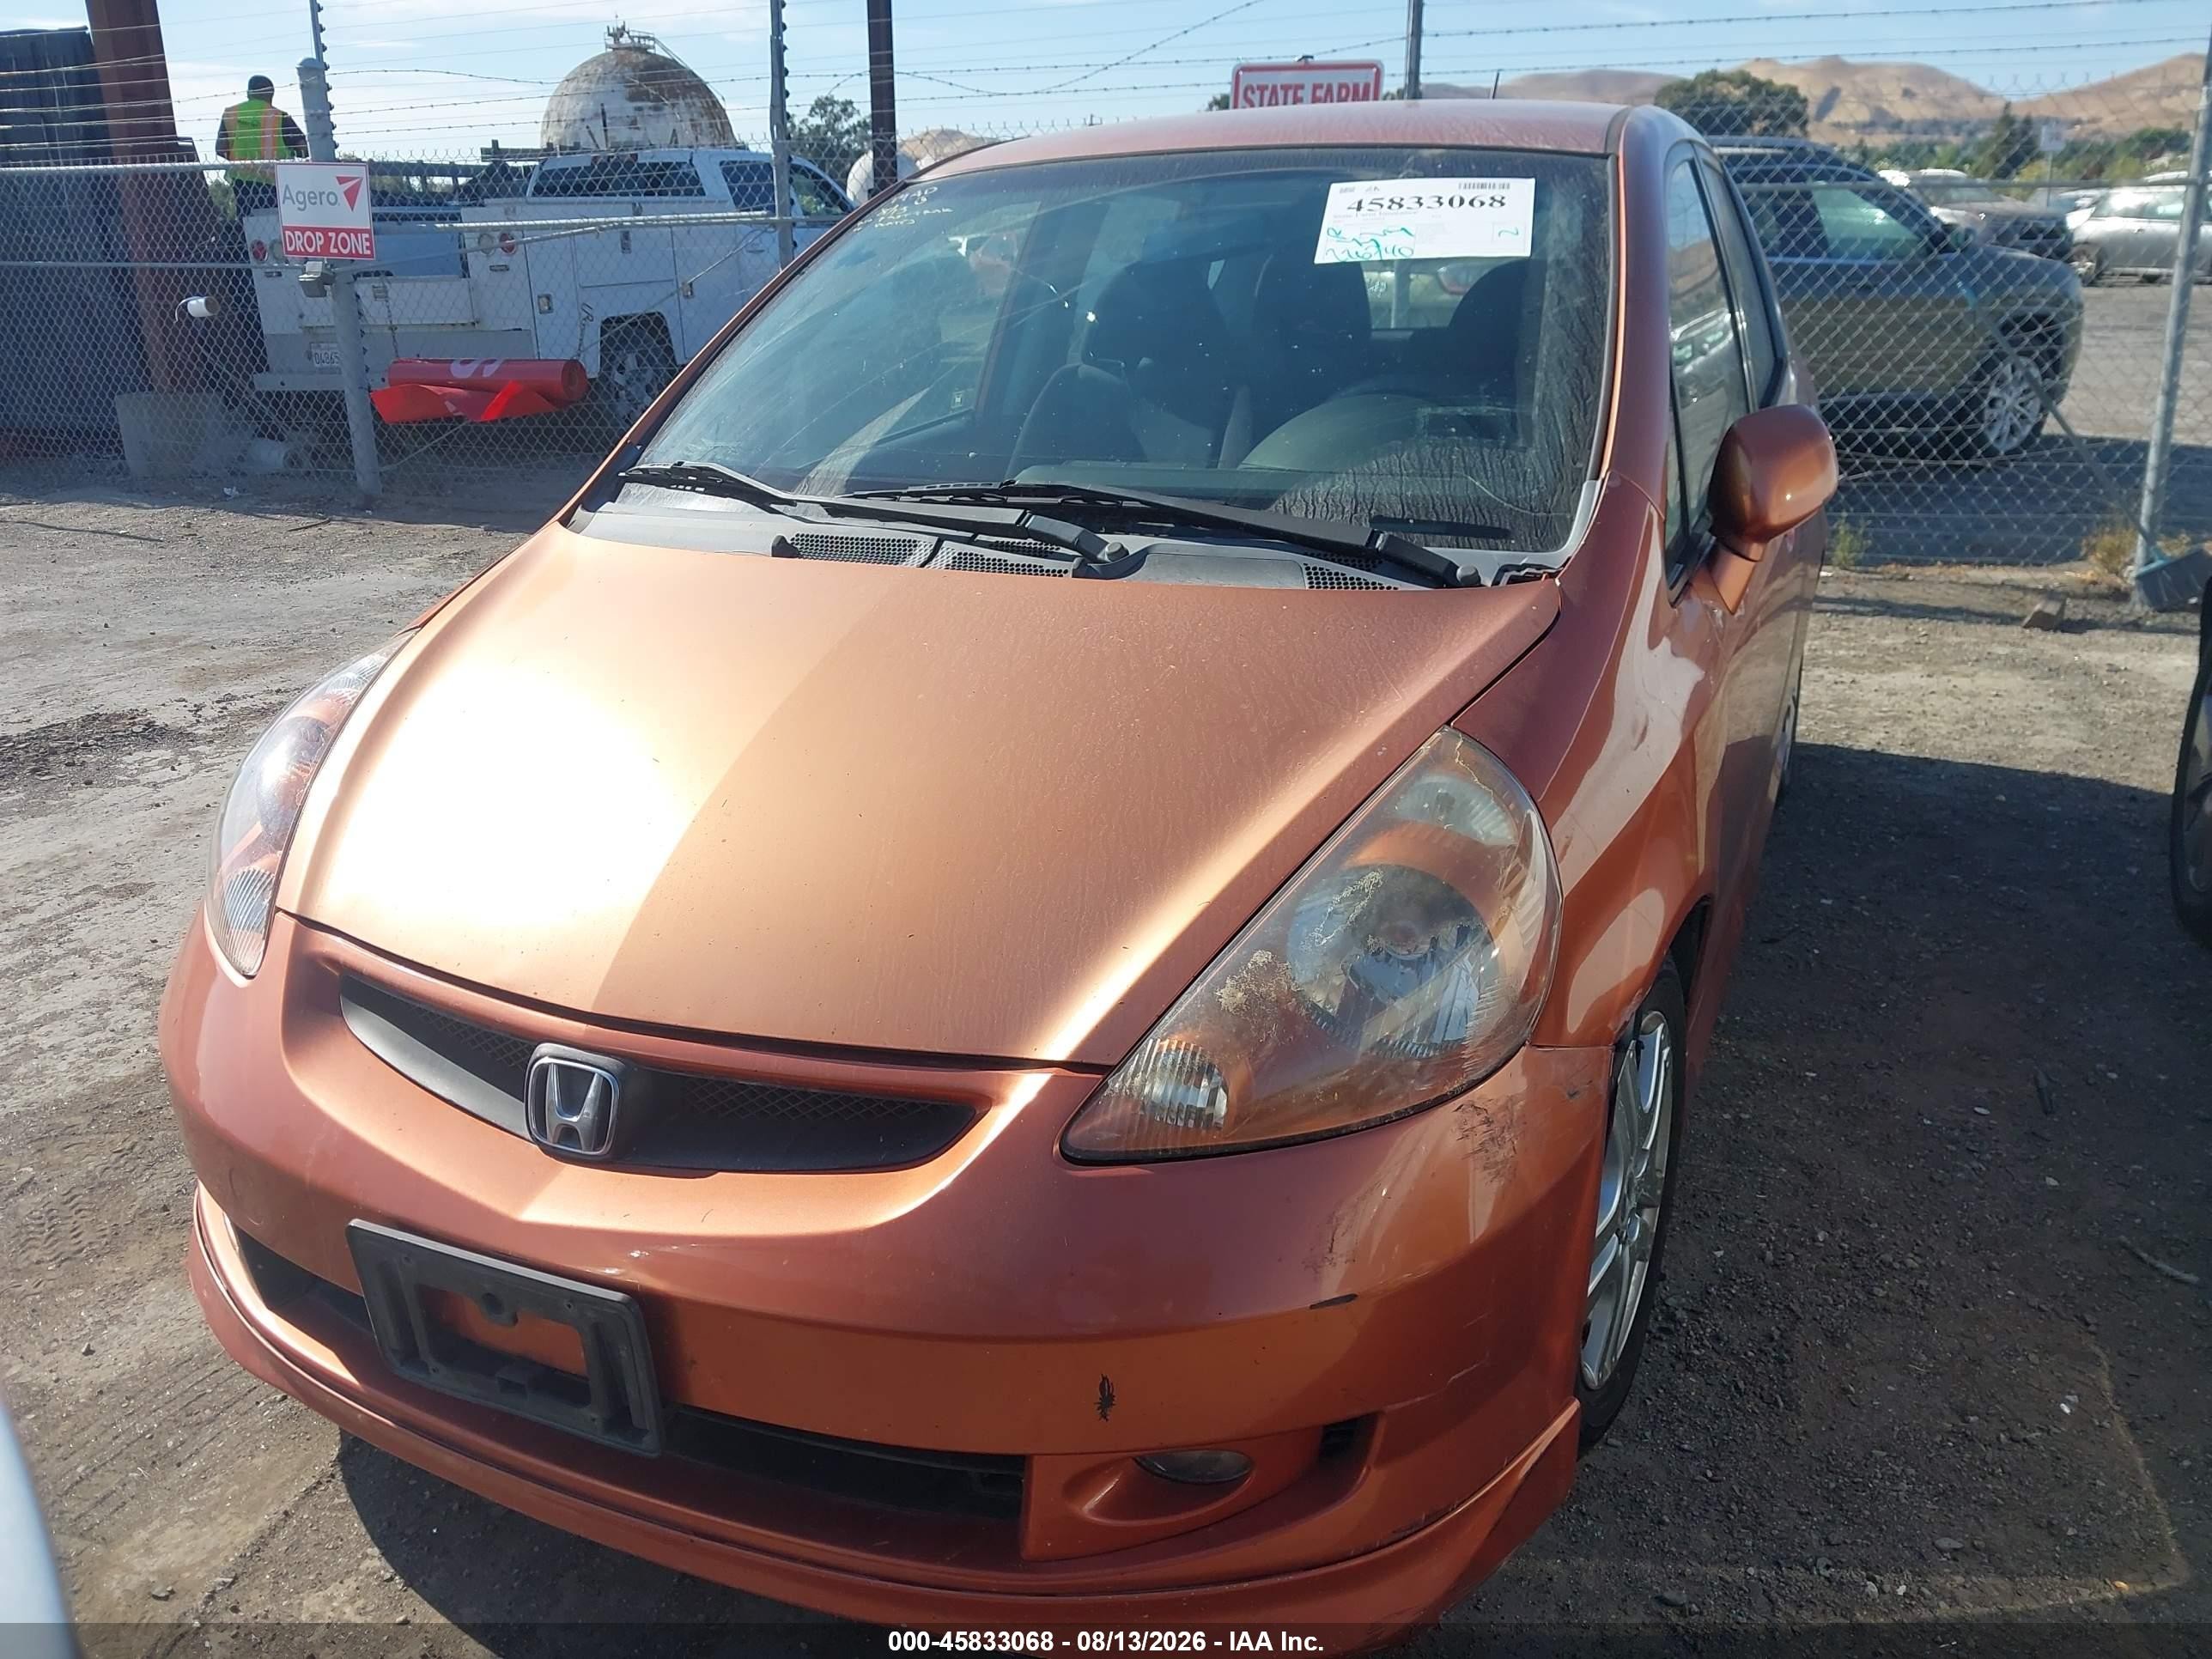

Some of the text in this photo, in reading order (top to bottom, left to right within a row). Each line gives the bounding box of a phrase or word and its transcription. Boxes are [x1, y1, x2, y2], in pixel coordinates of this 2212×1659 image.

[1243, 82, 1371, 108] STATE FARM
[282, 183, 338, 212] Agero
[1346, 194, 1507, 213] 45833068
[284, 230, 371, 255] DROP ZONE
